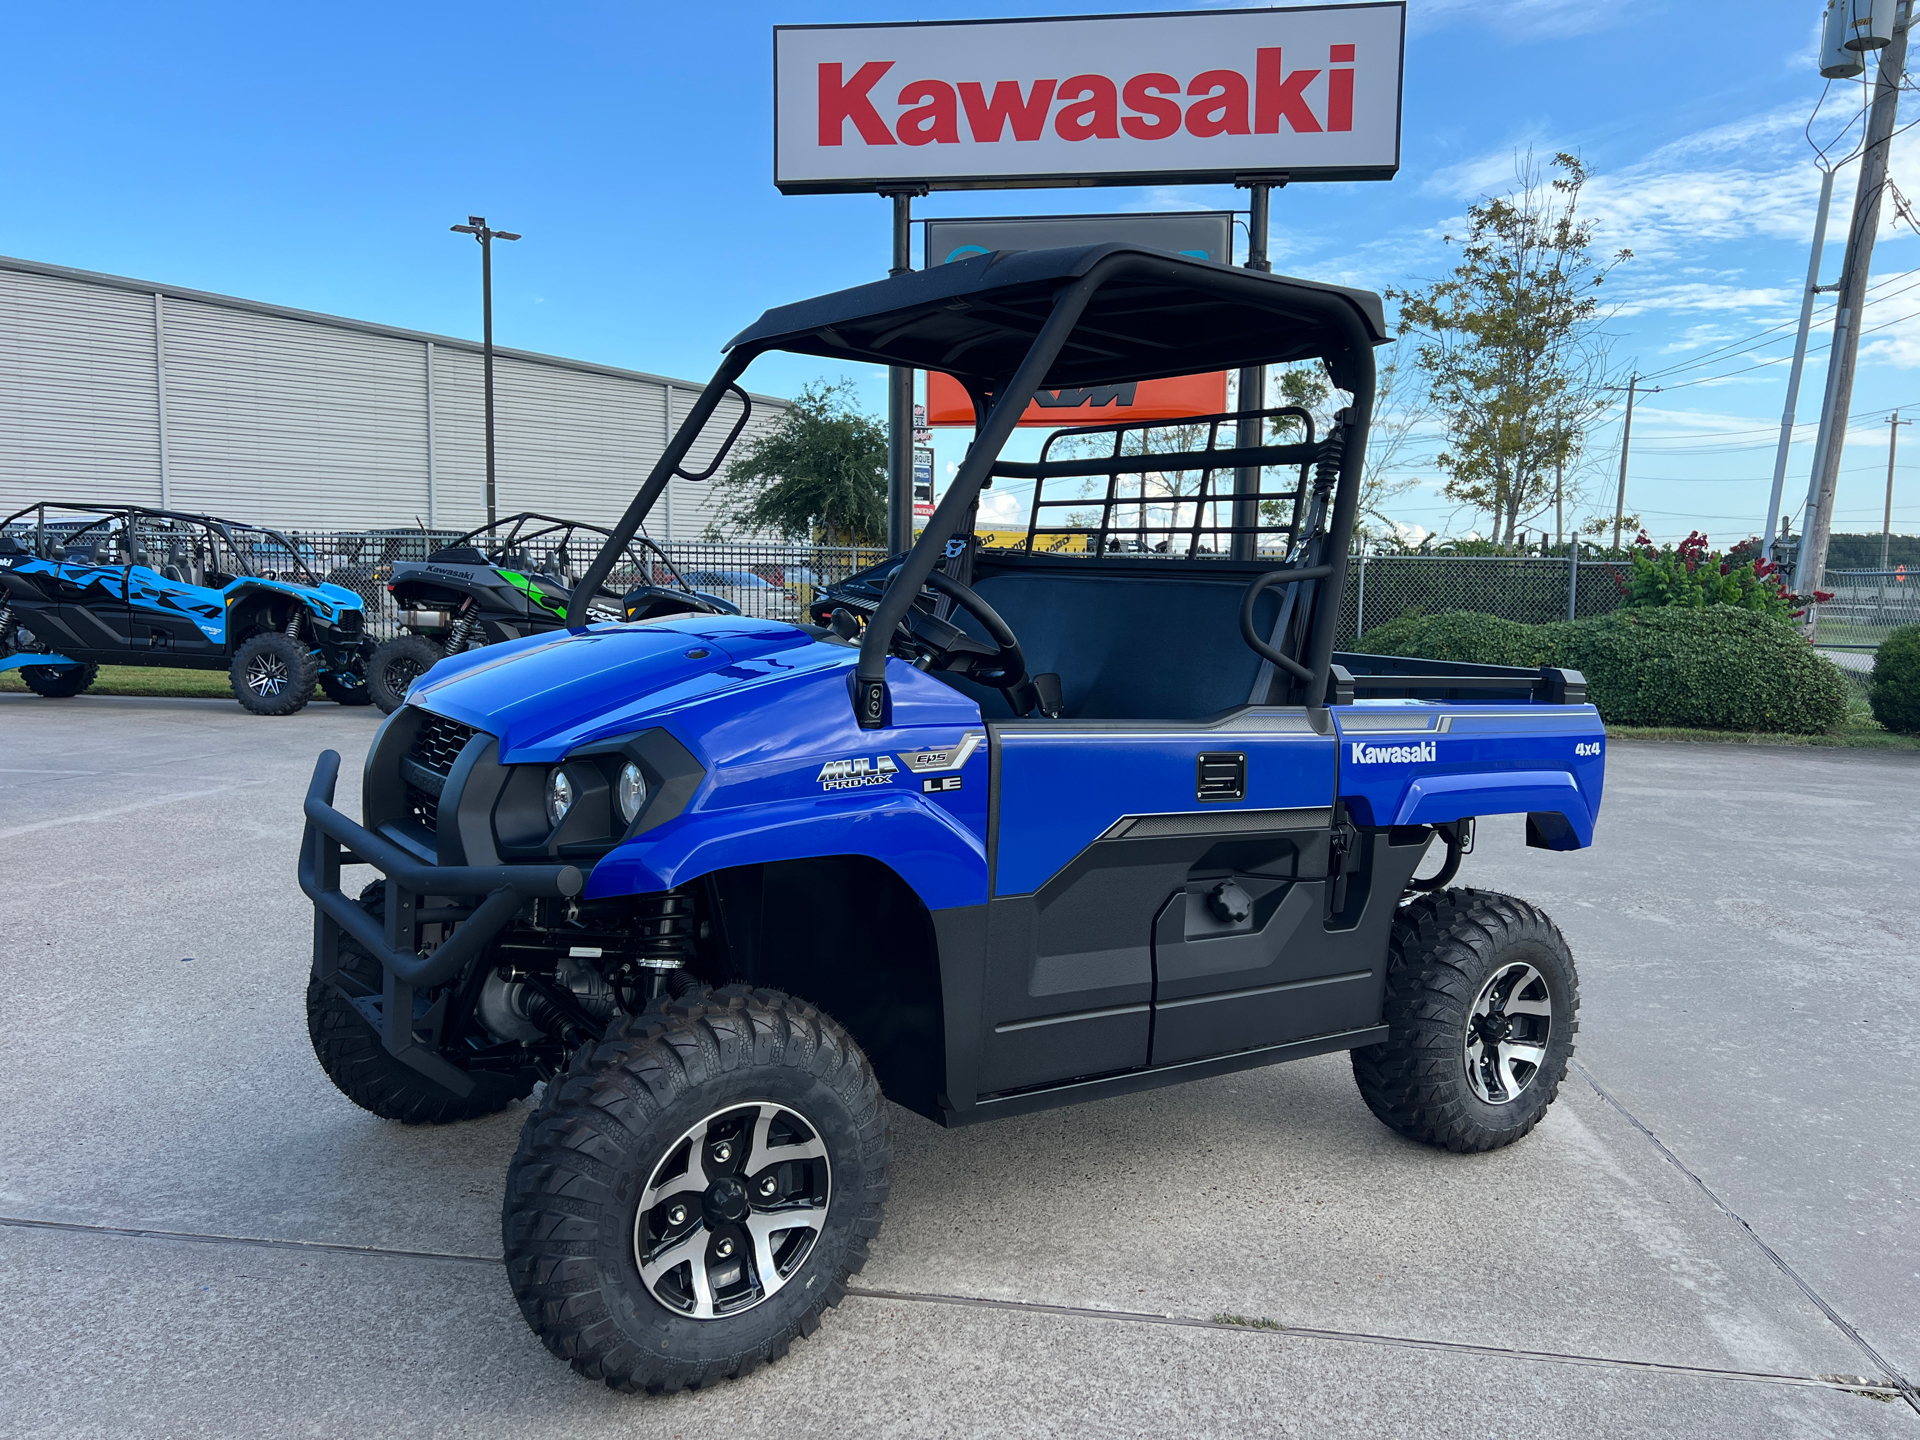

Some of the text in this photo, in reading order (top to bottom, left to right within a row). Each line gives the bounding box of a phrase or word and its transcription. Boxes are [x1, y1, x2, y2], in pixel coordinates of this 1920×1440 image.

[817, 43, 1356, 147] Kawasaki
[425, 564, 475, 581] Kawasaki
[1351, 741, 1437, 764] Kawasaki
[1574, 742, 1601, 756] 4x4
[816, 755, 900, 782] MULE
[823, 774, 893, 791] PRO-MX
[923, 777, 961, 793] LE
